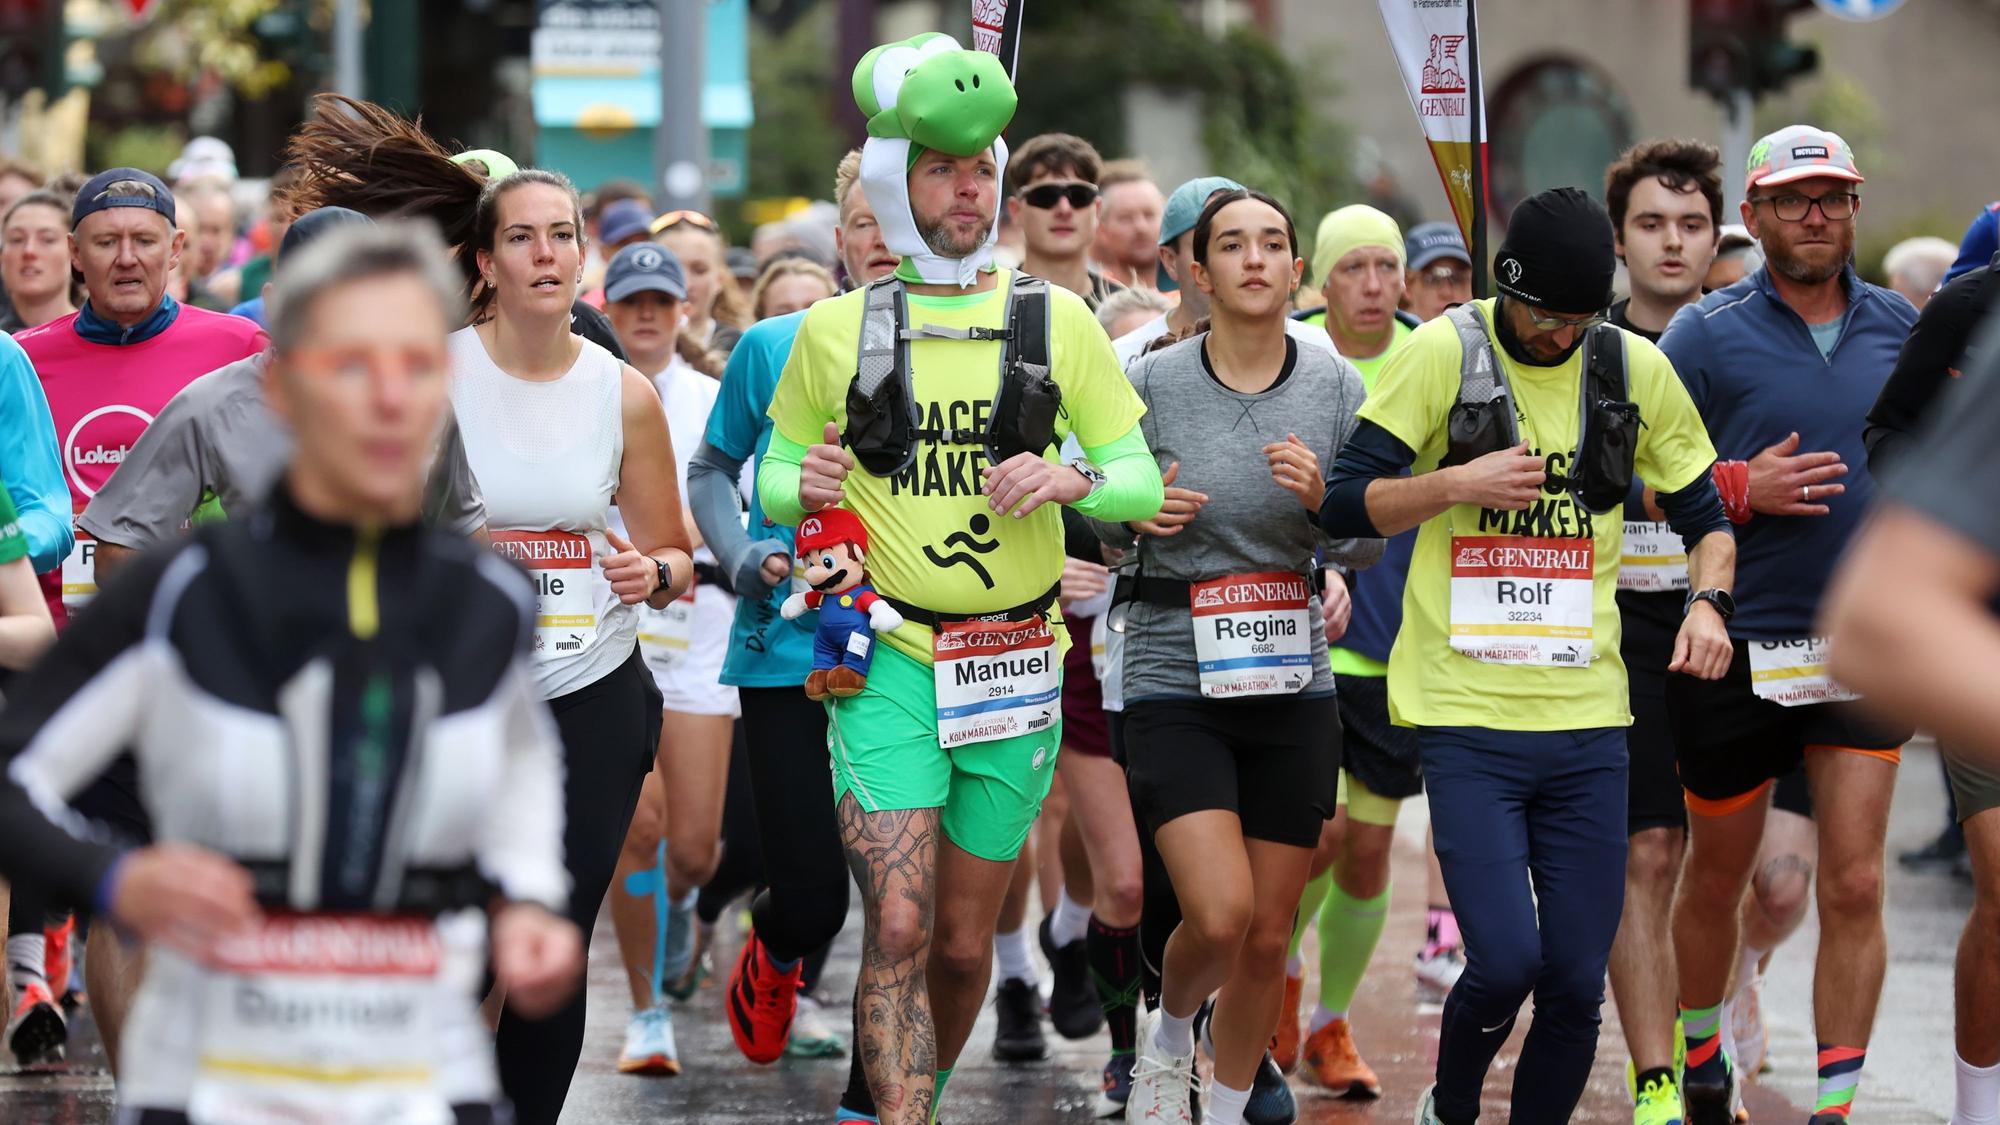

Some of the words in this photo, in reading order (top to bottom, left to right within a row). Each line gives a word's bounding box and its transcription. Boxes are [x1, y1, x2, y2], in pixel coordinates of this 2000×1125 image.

[74, 444, 130, 465] Lokal
[890, 450, 986, 497] MAKE
[1479, 499, 1594, 539] MAKER
[492, 540, 587, 560] GENERALI
[1633, 543, 1658, 553] 7812
[1489, 547, 1589, 570] GENERALI
[1225, 582, 1306, 604] GENERALI
[1497, 580, 1553, 605] Rolf
[1508, 611, 1543, 622] 32234
[966, 623, 1052, 648] GENERAL
[1215, 614, 1297, 642] Regina
[556, 641, 581, 651] PUMA
[1251, 643, 1276, 653] 6682
[1761, 636, 1829, 651] Step
[1484, 649, 1529, 660] MARATHON
[1551, 652, 1576, 662] PUMA
[955, 651, 1049, 686] Manuel
[988, 685, 1015, 697] 2914
[1231, 680, 1269, 692] MARATHON
[1785, 688, 1827, 701] MARATHON
[1028, 717, 1049, 730] PUMA
[967, 724, 1007, 740] MARATHON
